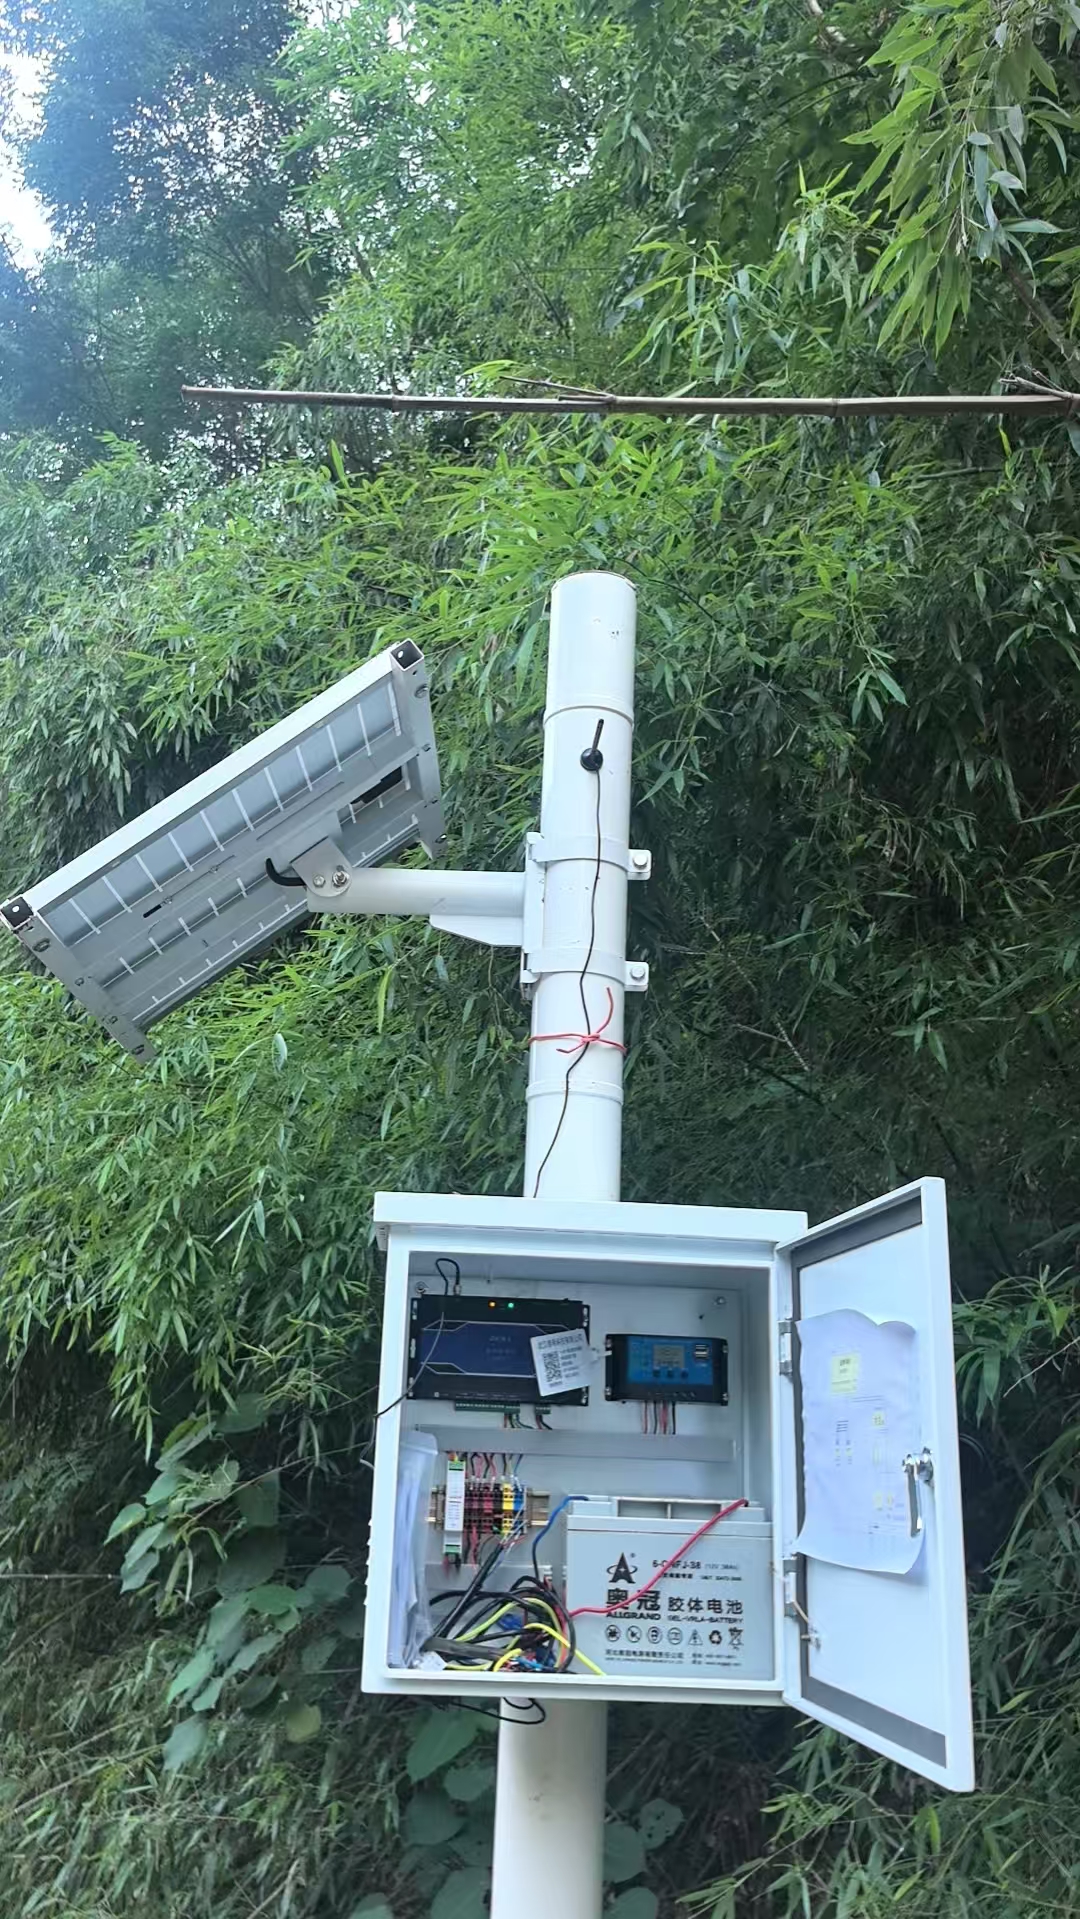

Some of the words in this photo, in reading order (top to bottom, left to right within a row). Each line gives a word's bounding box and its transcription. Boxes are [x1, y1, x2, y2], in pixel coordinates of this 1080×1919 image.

[668, 1597, 743, 1615] 胶体电池
[606, 1612, 661, 1621] ALLGRAND
